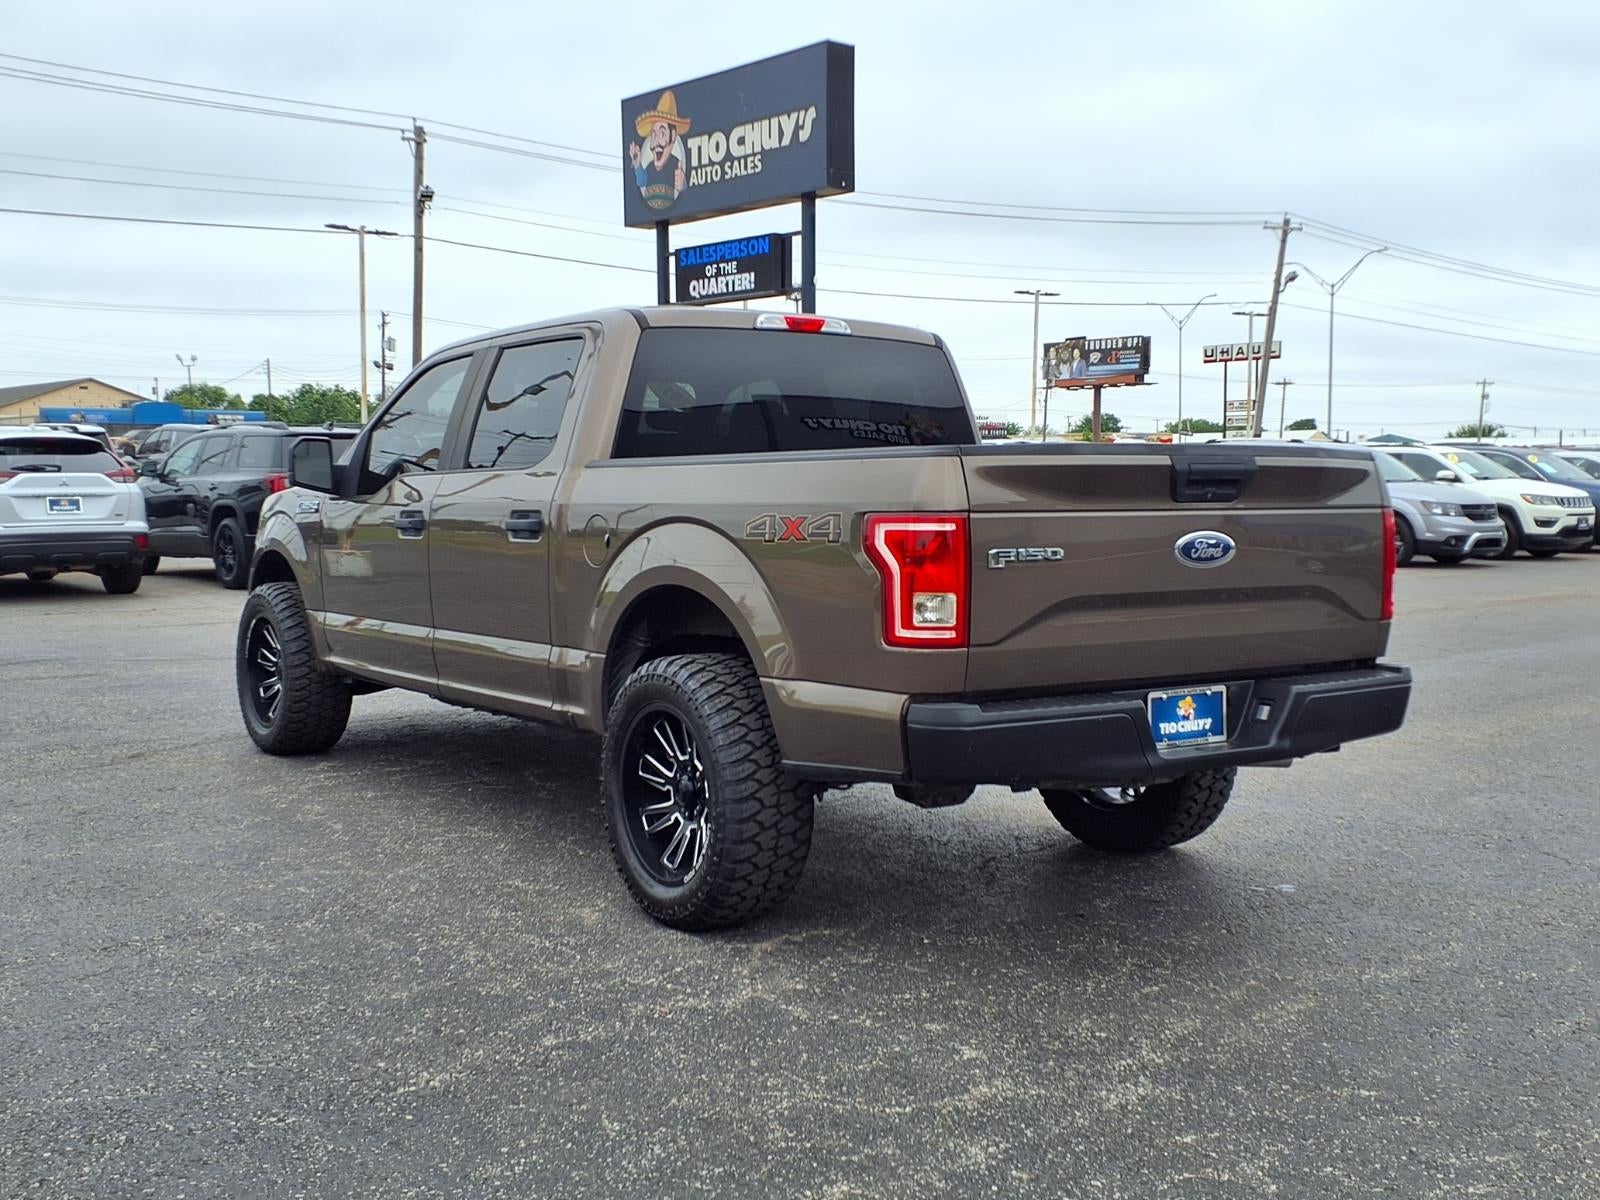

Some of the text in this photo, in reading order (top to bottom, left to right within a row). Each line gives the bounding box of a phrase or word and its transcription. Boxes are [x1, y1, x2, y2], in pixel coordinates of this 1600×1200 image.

[687, 105, 816, 167] TIO CHUY'S
[689, 154, 762, 187] AUTO SALES
[680, 237, 769, 267] SALESPERSON
[705, 261, 737, 277] OF THE
[689, 272, 755, 298] QUARTER!
[1191, 538, 1224, 558] Ford
[1159, 722, 1177, 735] TIO
